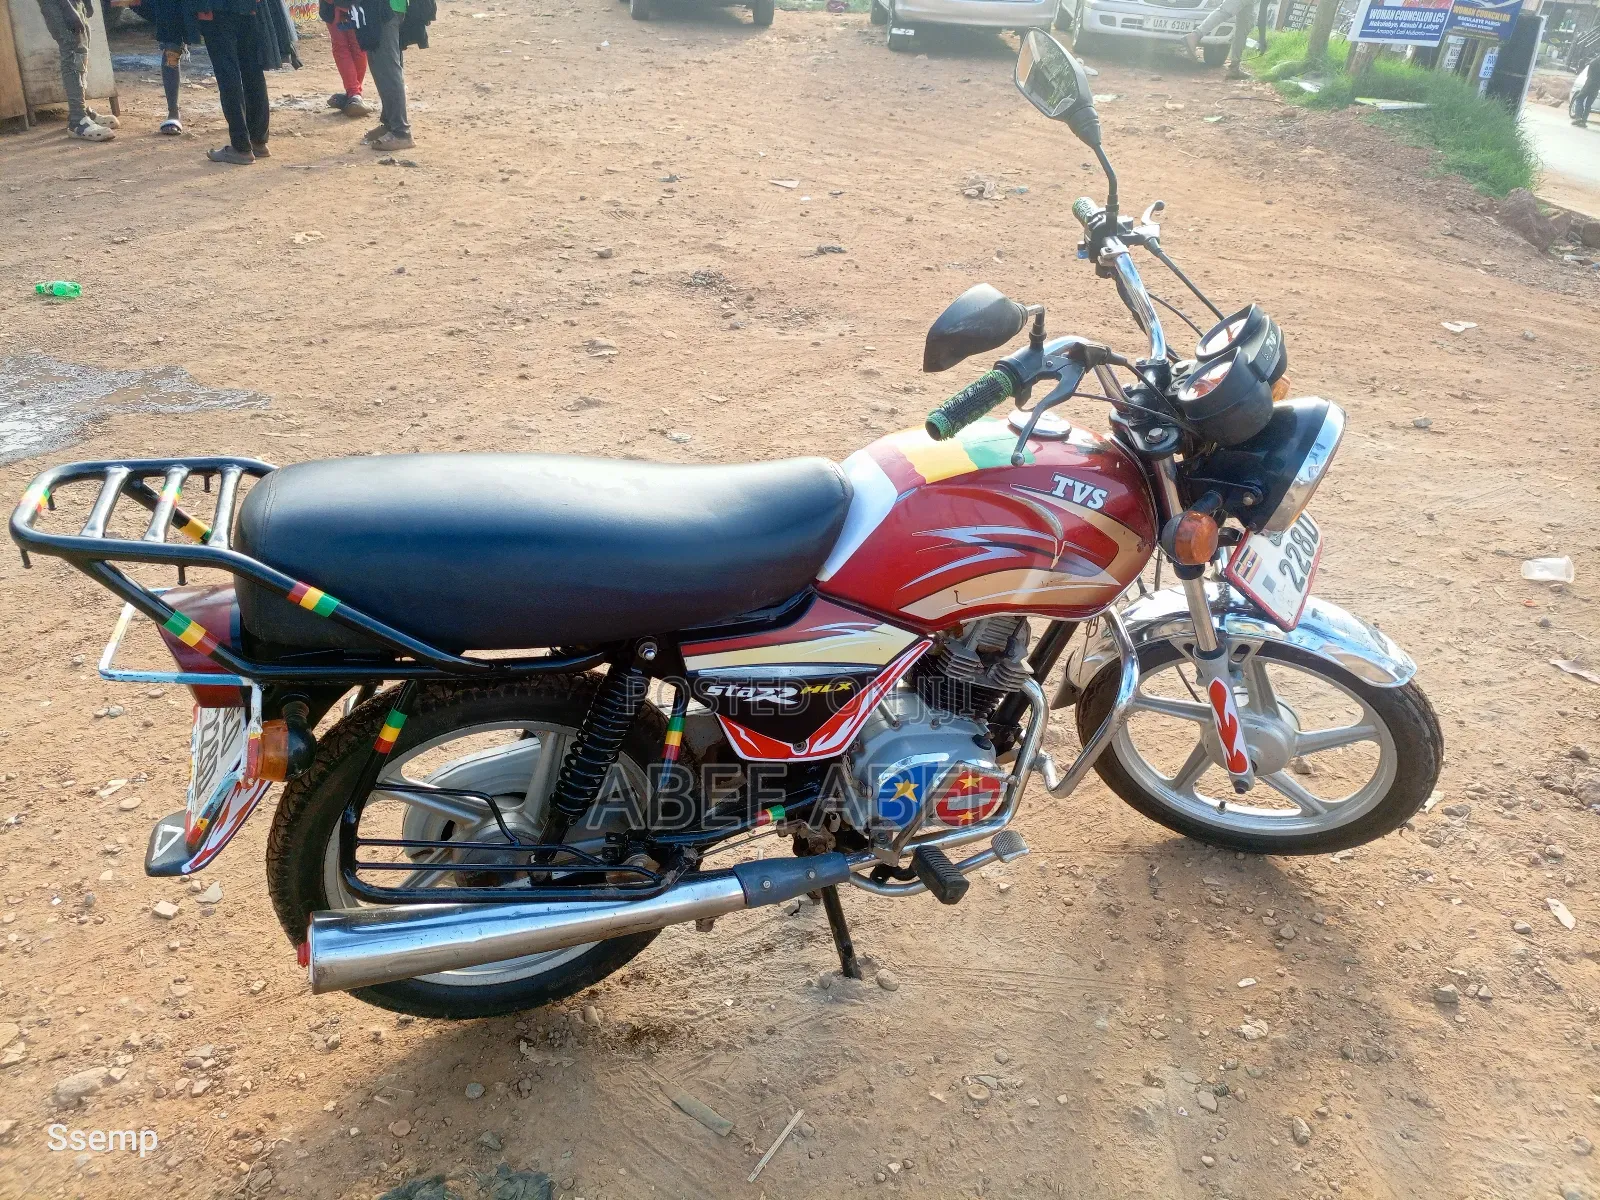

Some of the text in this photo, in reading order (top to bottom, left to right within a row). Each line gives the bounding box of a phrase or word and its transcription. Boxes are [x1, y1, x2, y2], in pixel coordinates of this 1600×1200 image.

[1369, 9, 1446, 23] WOMAN COUNCILLOR LC5
[1153, 19, 1169, 29] UAX
[1051, 472, 1109, 511] TVS
[800, 682, 854, 695] HLX
